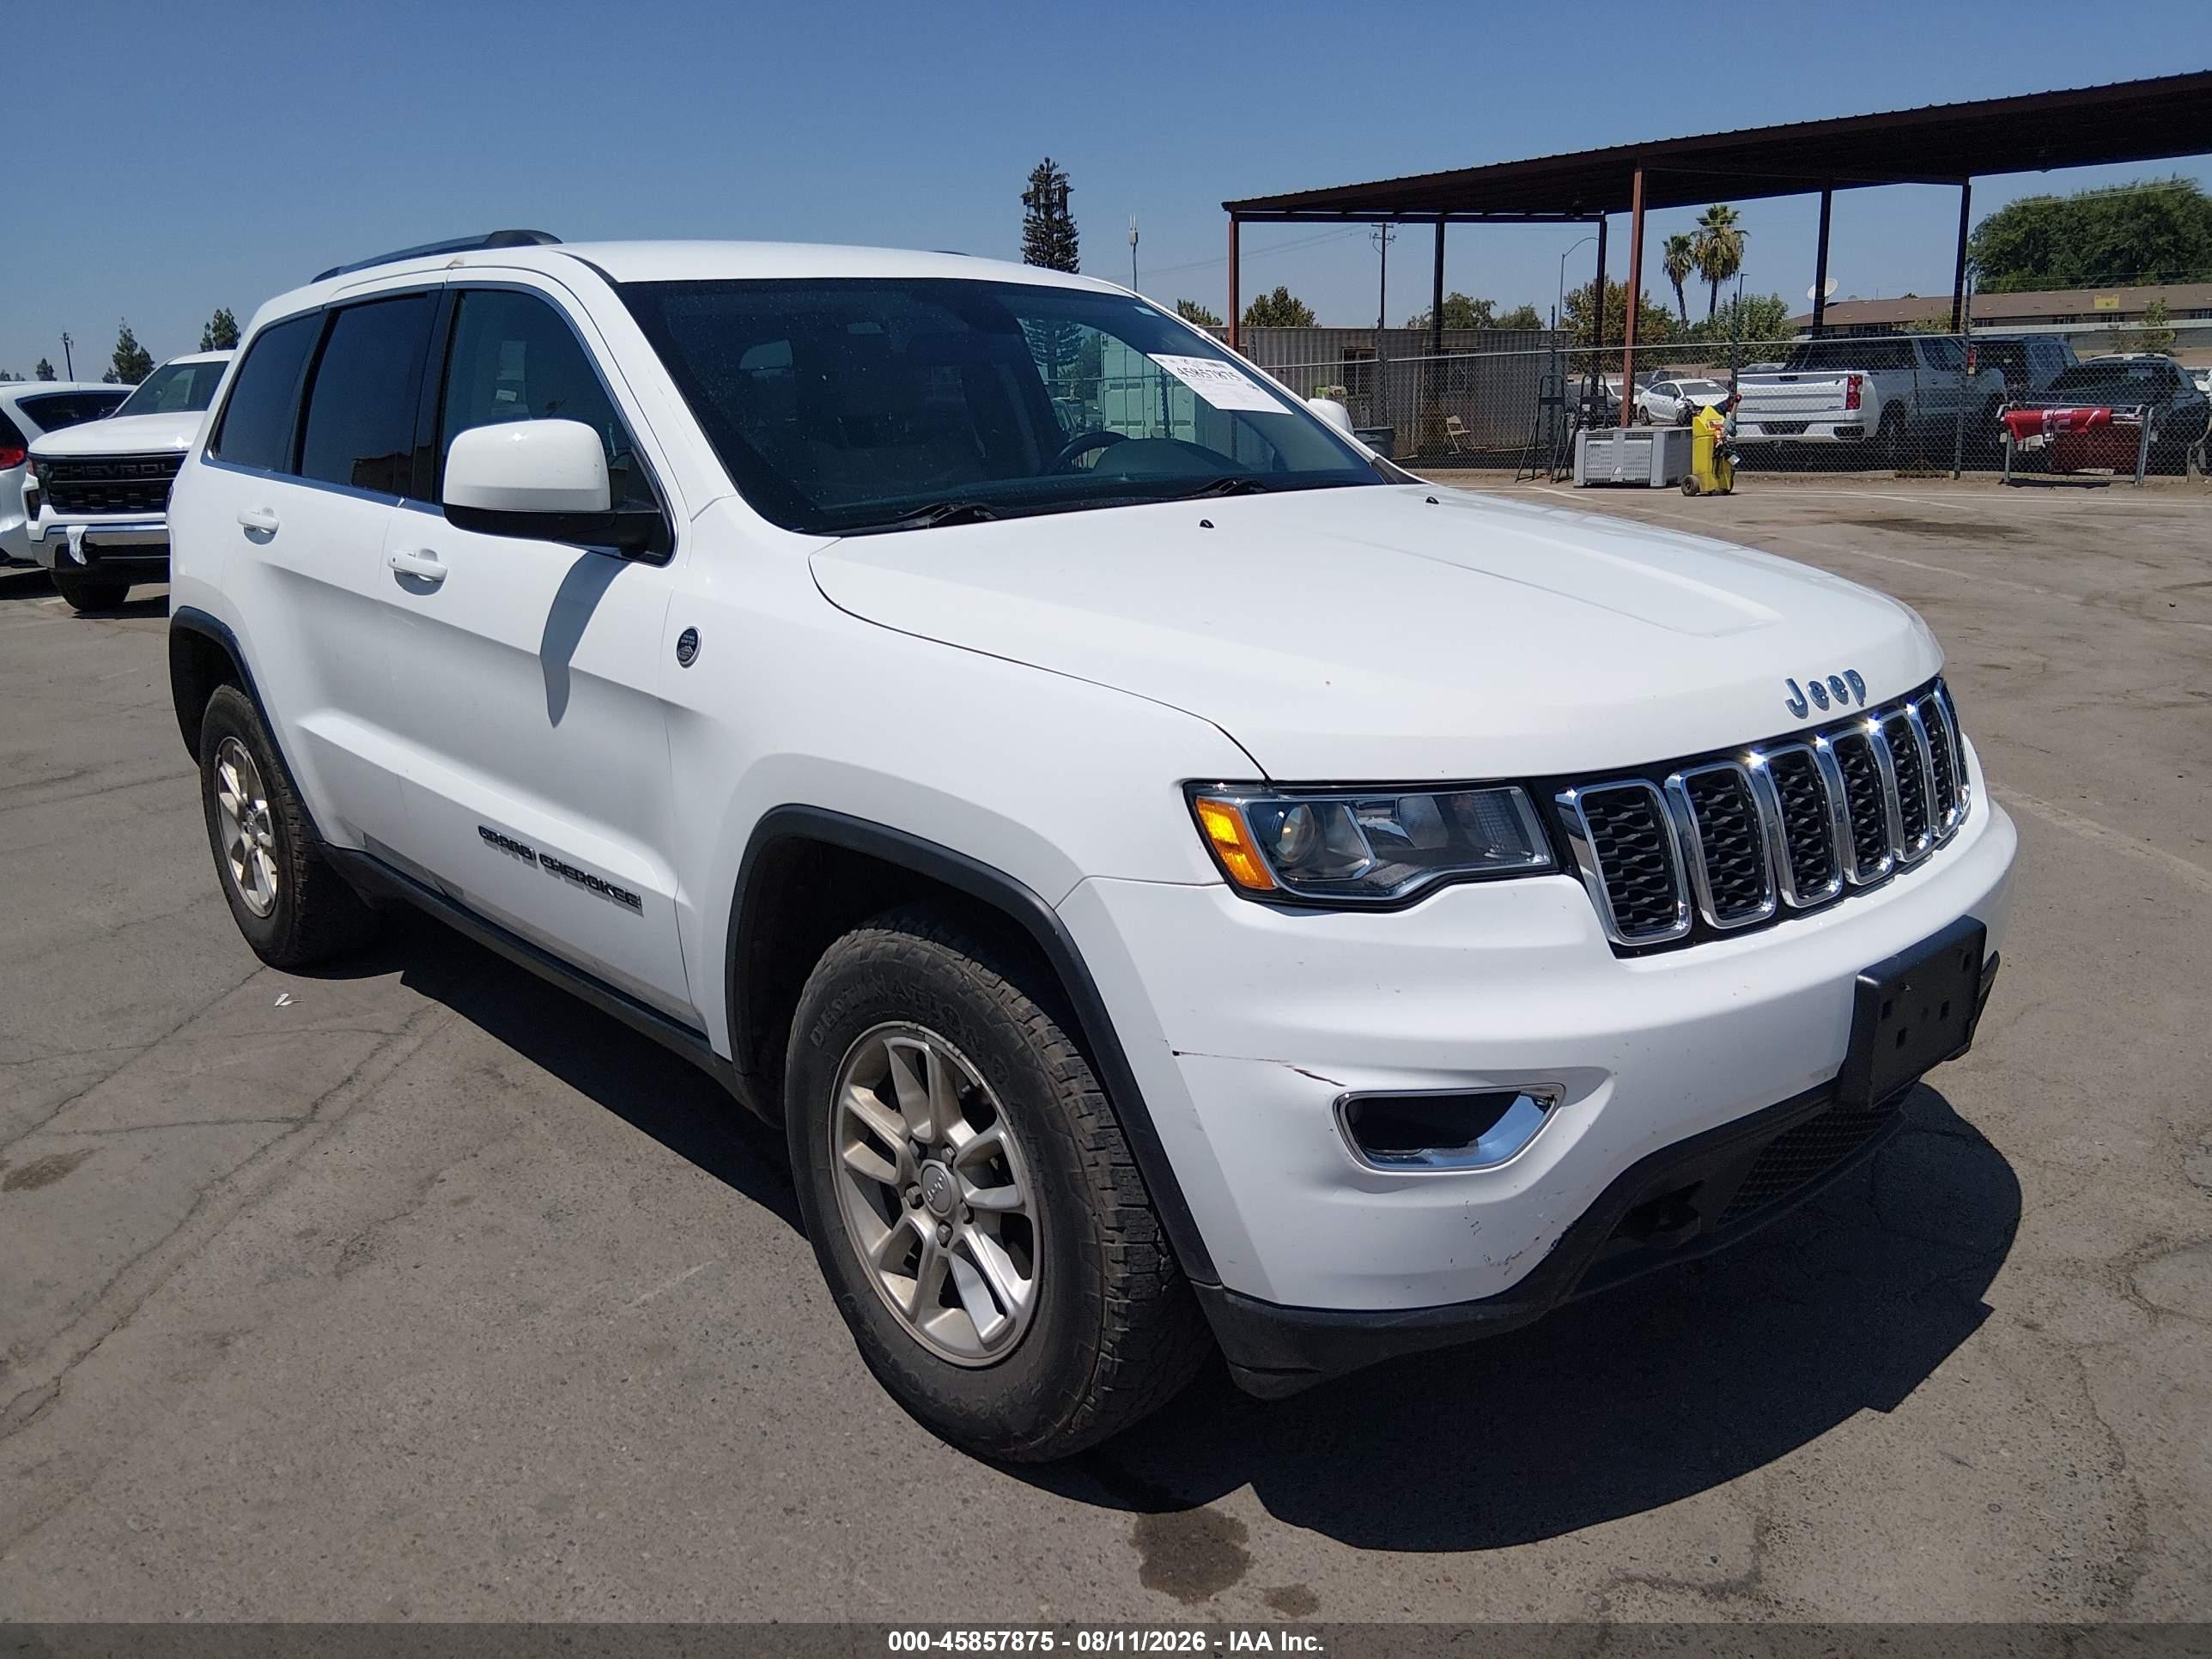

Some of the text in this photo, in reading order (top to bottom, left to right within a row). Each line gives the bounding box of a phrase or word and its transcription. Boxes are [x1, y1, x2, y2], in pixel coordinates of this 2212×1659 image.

[1176, 367, 1242, 382] 45857875
[1785, 669, 1866, 720] Jeep
[478, 825, 643, 909] GRAND CHEROKEE
